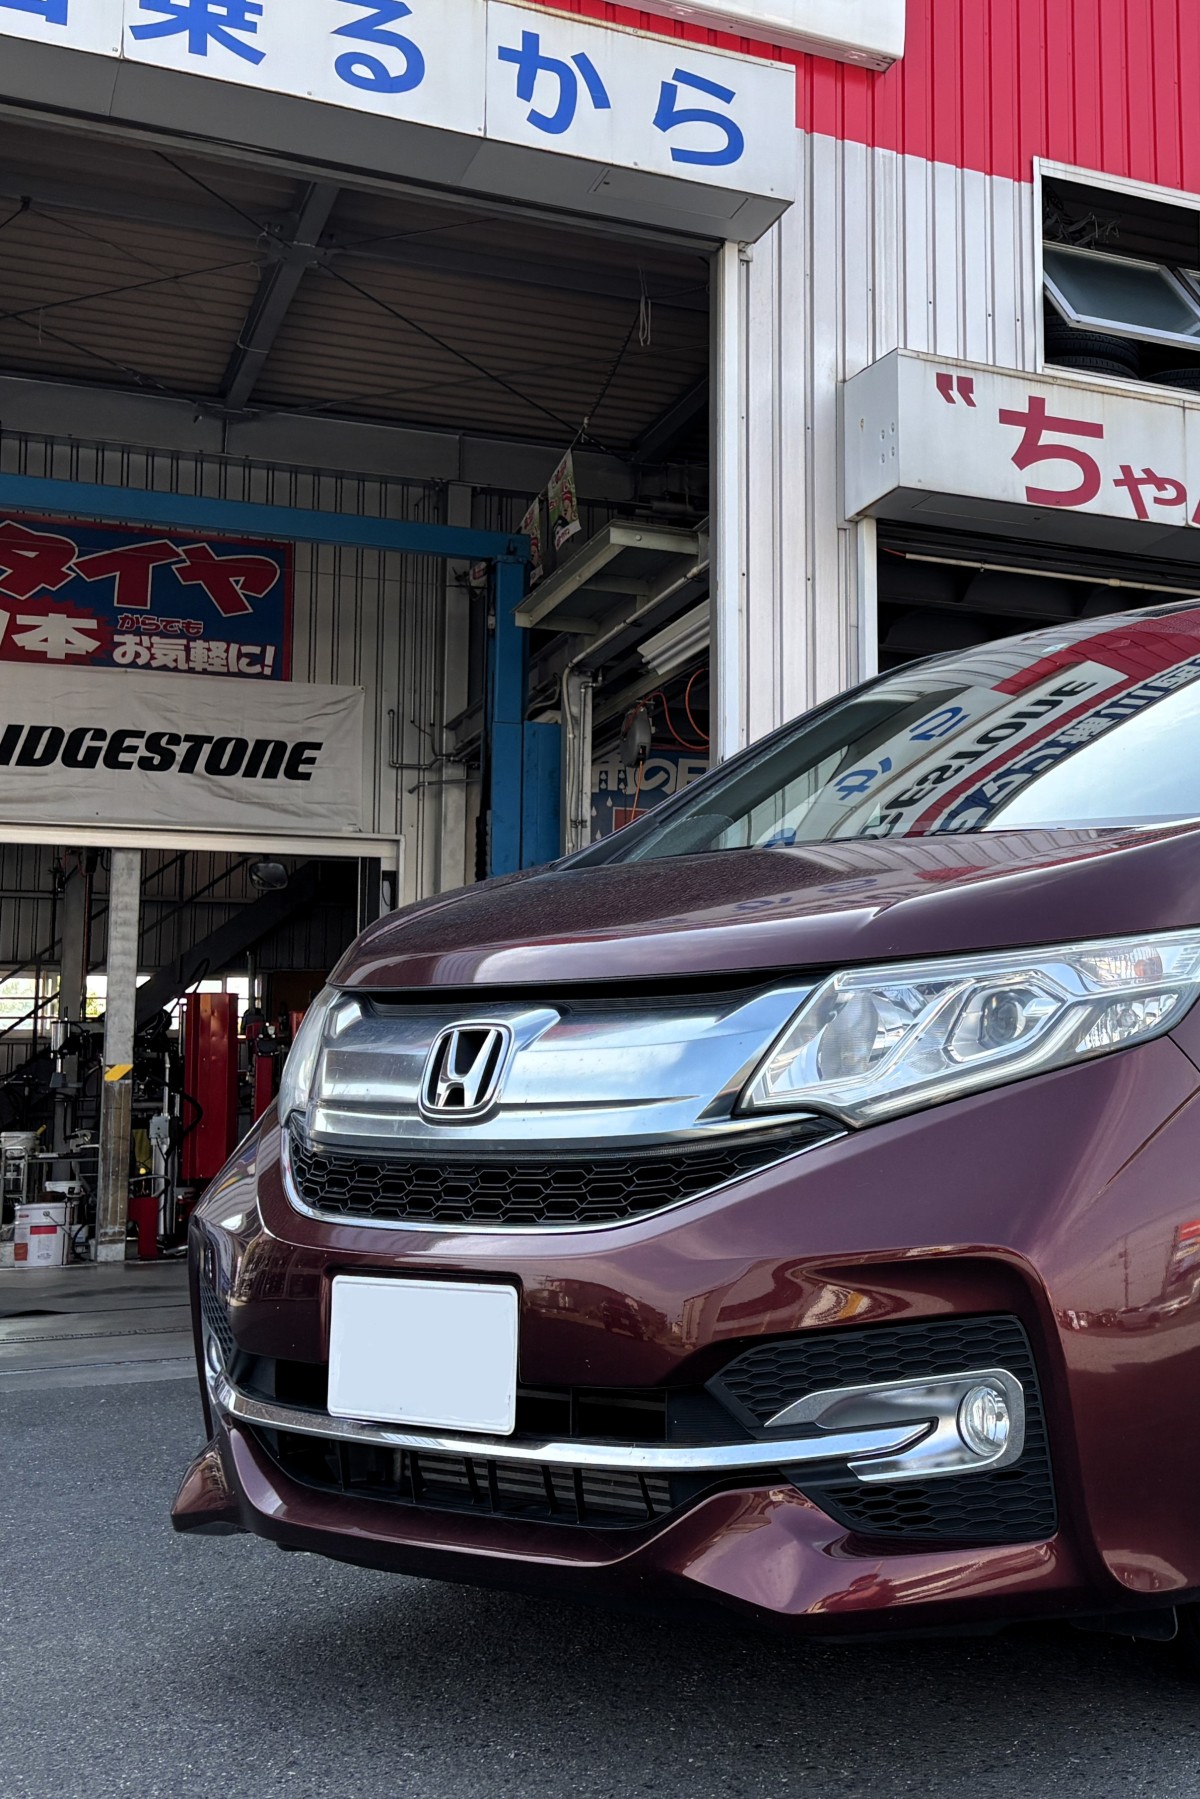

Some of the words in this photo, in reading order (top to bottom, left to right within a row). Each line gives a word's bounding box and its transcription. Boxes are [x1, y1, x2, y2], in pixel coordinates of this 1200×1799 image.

[0, 0, 745, 166] 乗るから
[0, 520, 280, 617] タイヤ
[118, 613, 203, 636] からでも
